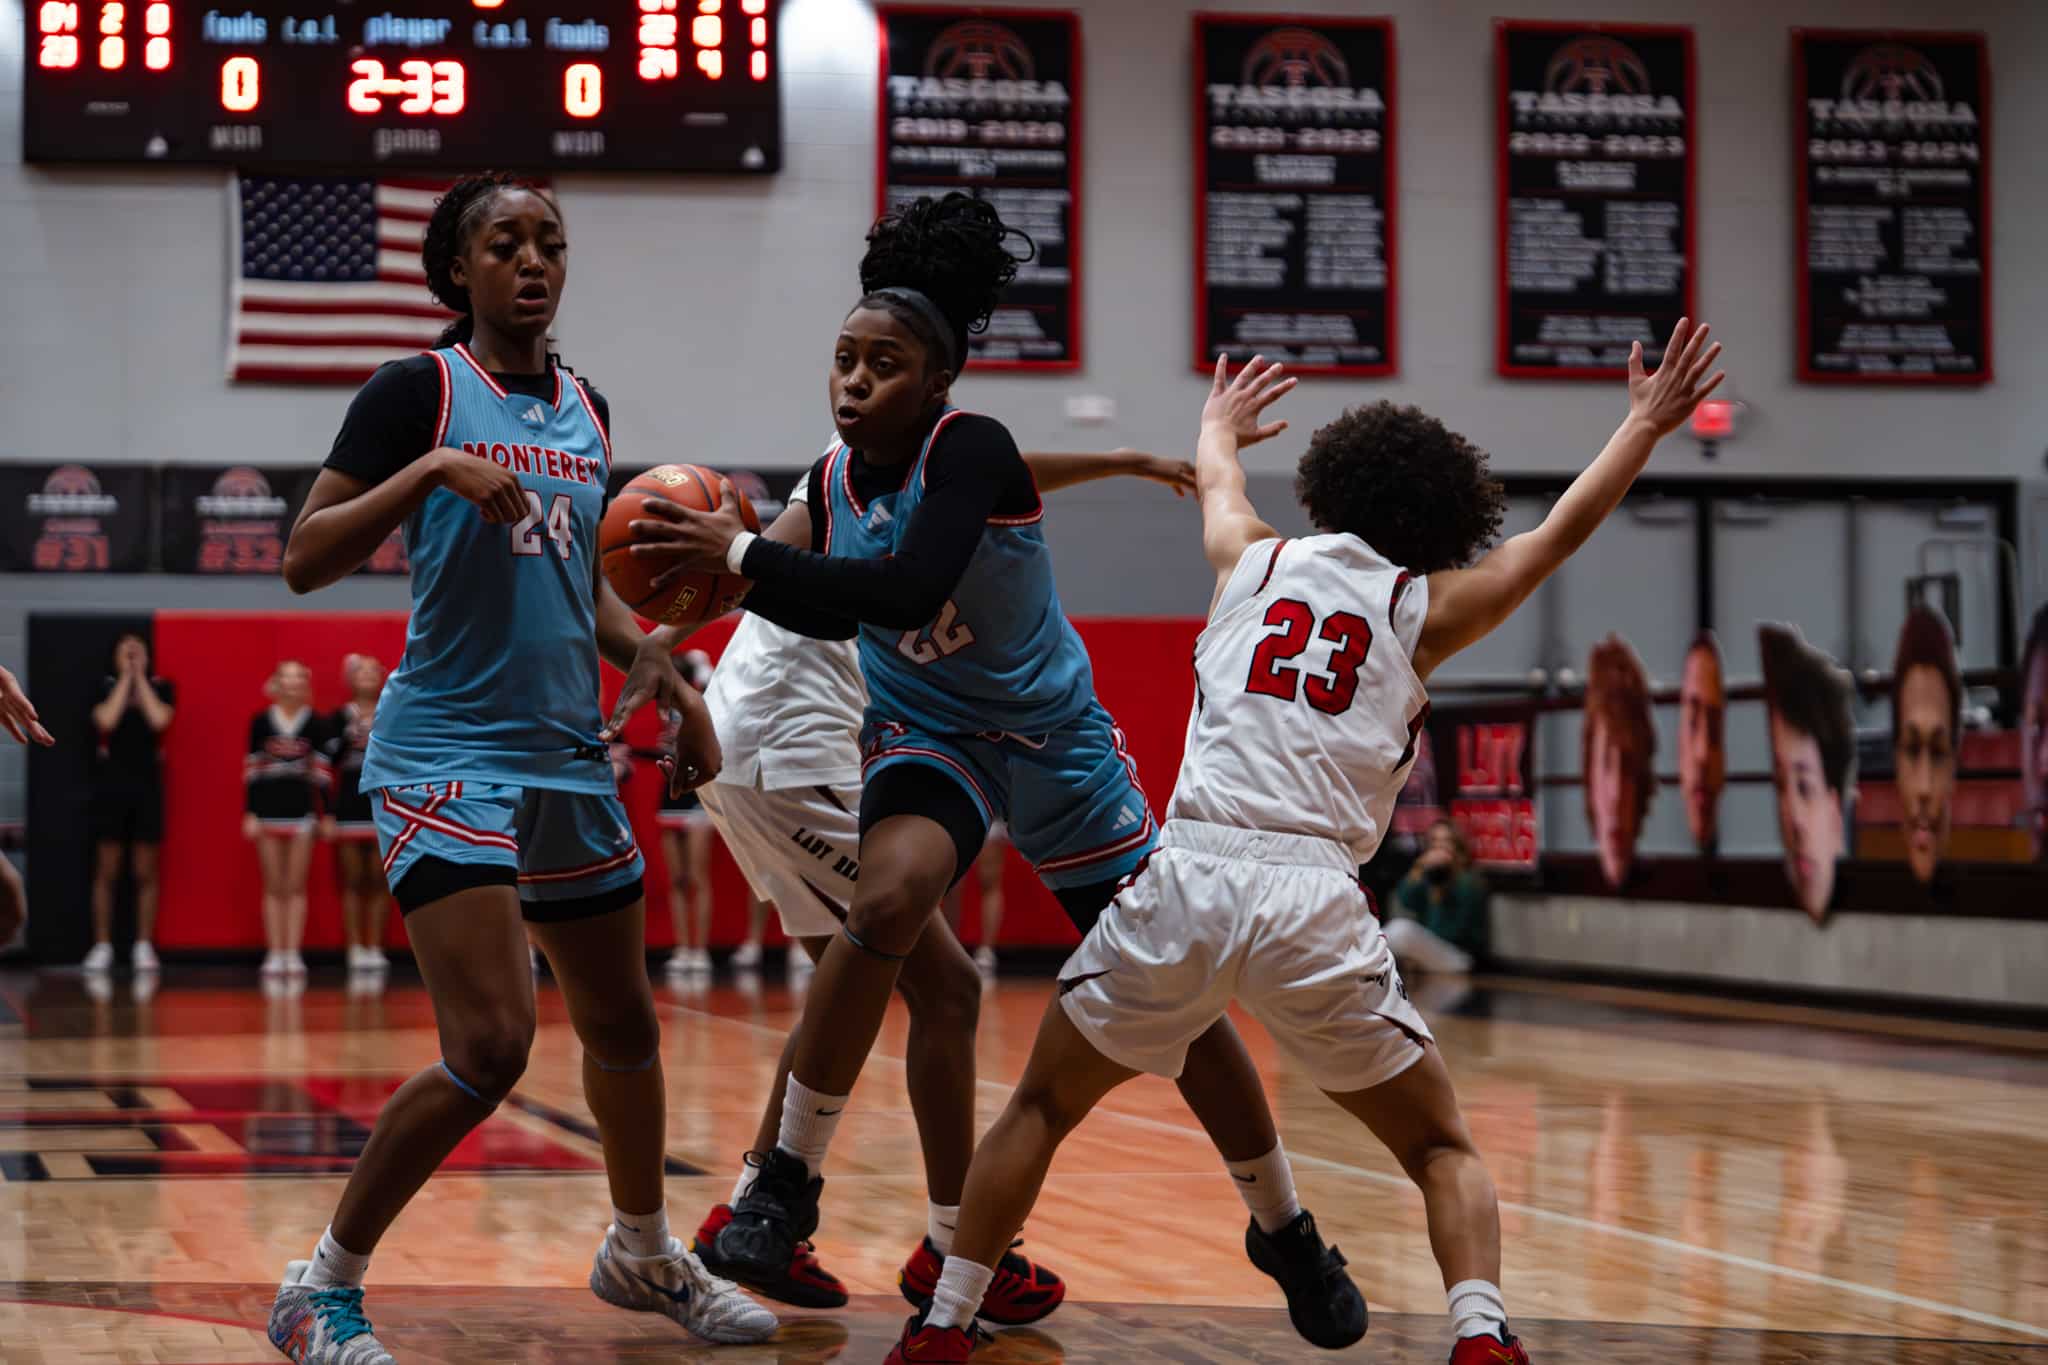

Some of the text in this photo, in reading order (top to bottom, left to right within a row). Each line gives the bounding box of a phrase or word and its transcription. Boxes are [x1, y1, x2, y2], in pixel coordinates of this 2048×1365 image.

[203, 9, 268, 42] fouls
[364, 11, 451, 47] player
[544, 17, 609, 50] fouls
[222, 57, 260, 111] 0
[565, 64, 601, 117] 0
[888, 76, 1069, 102] TASCOSA
[1207, 84, 1384, 110] TASCOSA
[1509, 90, 1685, 118] TASCOSA
[1808, 98, 1978, 125] TASCOSA
[462, 441, 600, 486] MONTEREY
[512, 489, 572, 560] 24
[1245, 598, 1373, 716] 23
[792, 828, 834, 859] LADY
